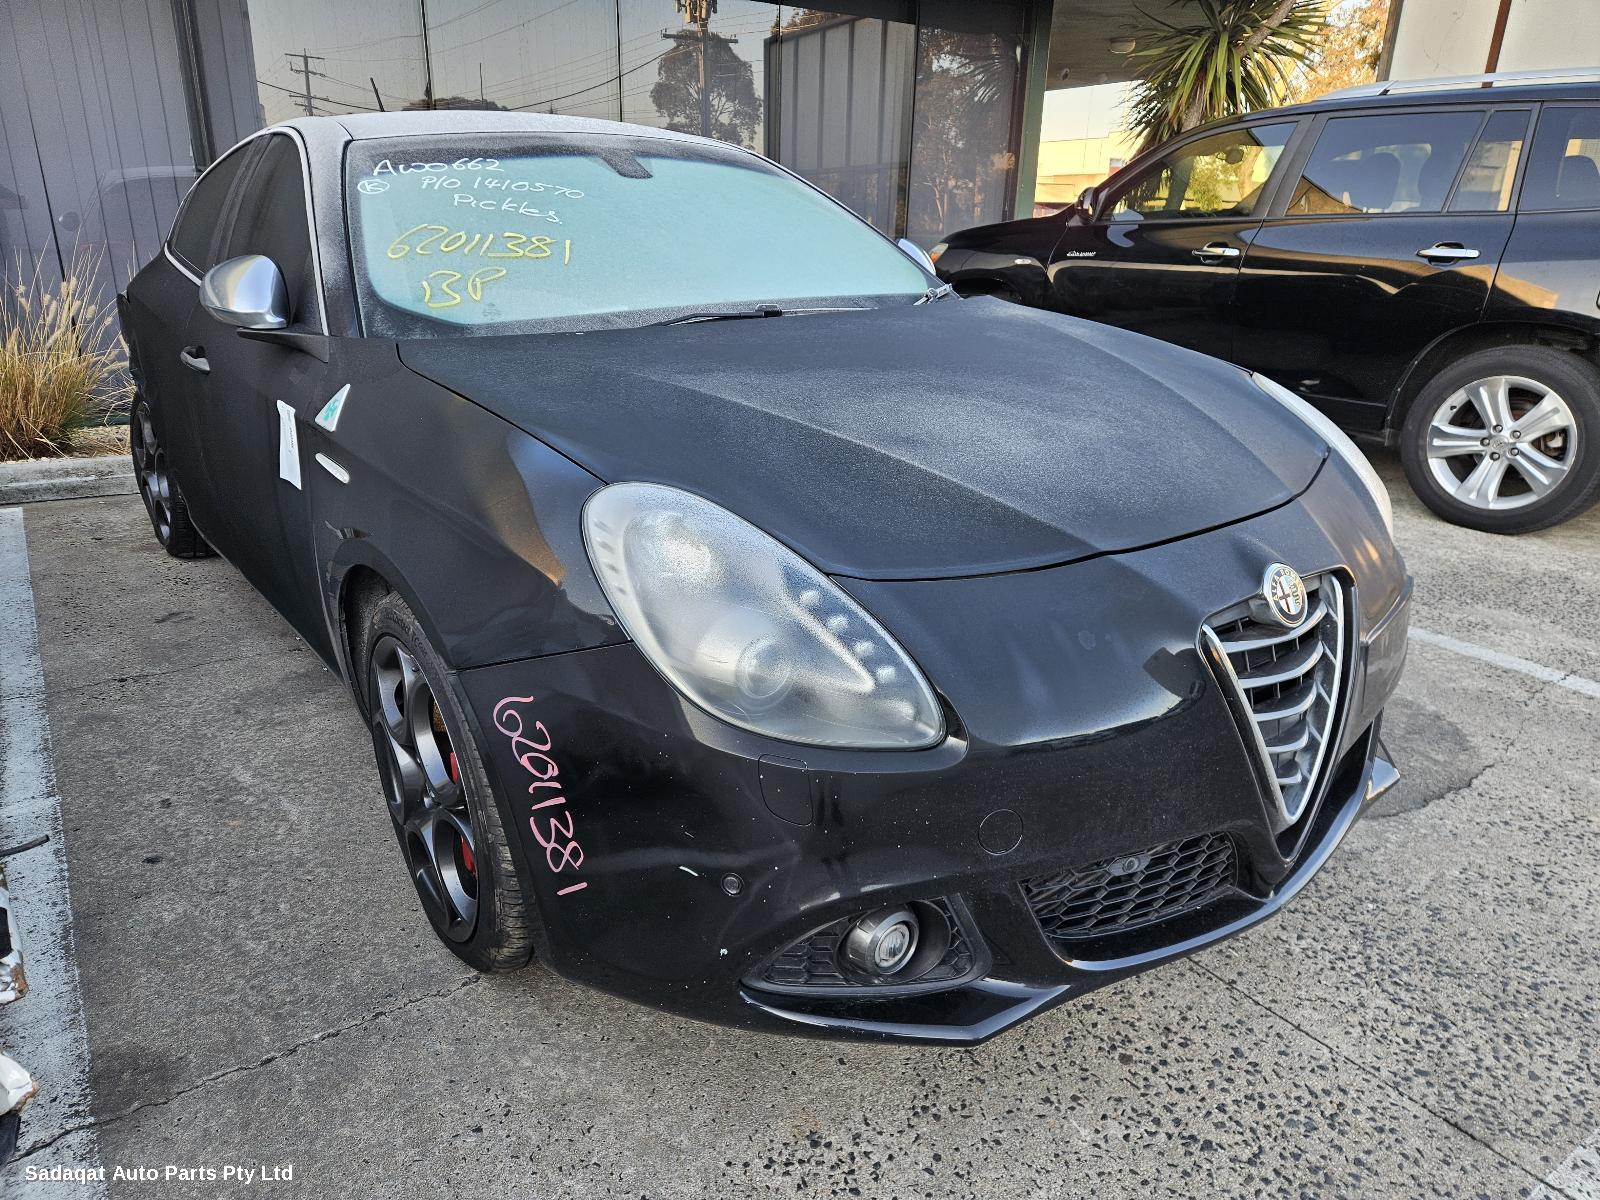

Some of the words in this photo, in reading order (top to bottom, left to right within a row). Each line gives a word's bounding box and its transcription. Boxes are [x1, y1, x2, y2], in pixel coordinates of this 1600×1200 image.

[474, 177, 585, 199] 1410570
[387, 223, 571, 265] 62011381
[492, 695, 588, 896] 62011381
